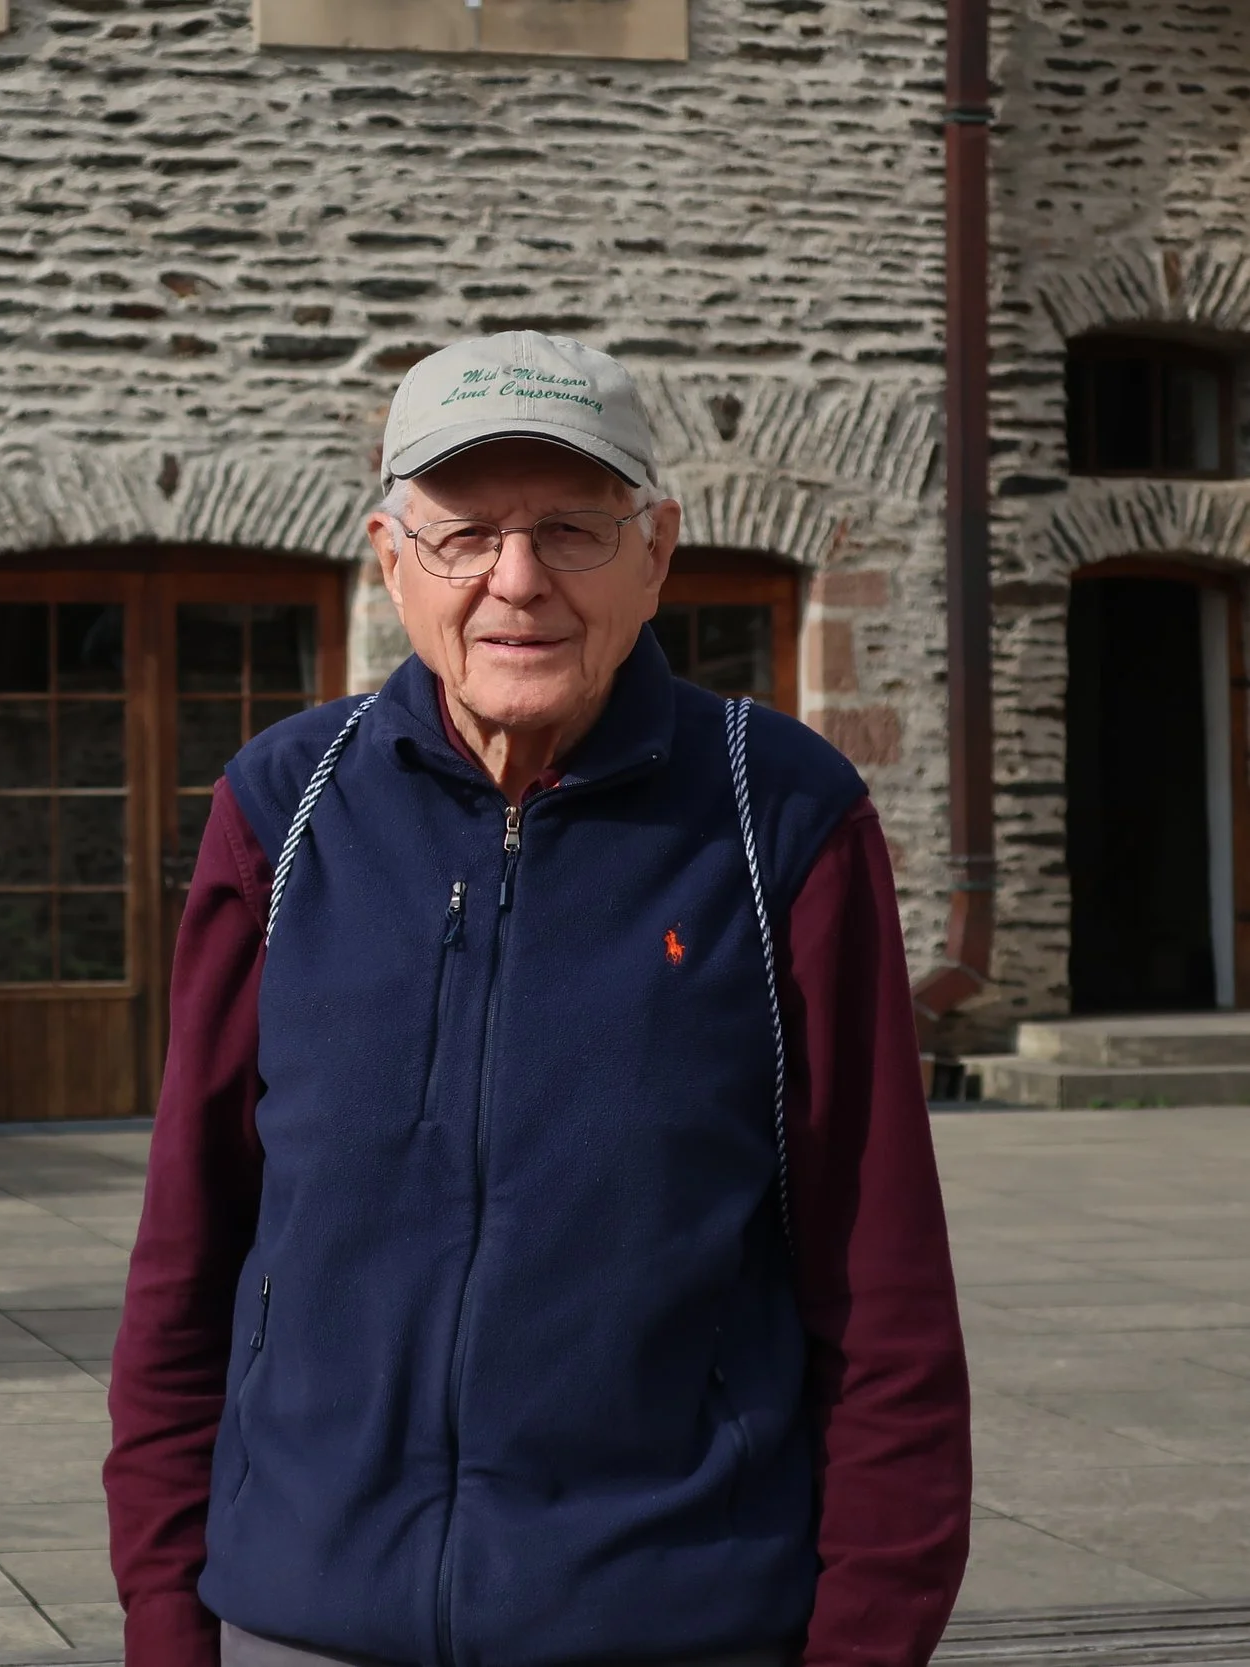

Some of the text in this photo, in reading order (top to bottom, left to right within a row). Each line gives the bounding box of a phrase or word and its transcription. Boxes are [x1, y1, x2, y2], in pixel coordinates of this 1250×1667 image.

[512, 367, 588, 387] Michigan
[441, 380, 604, 415] Land Conservancy
